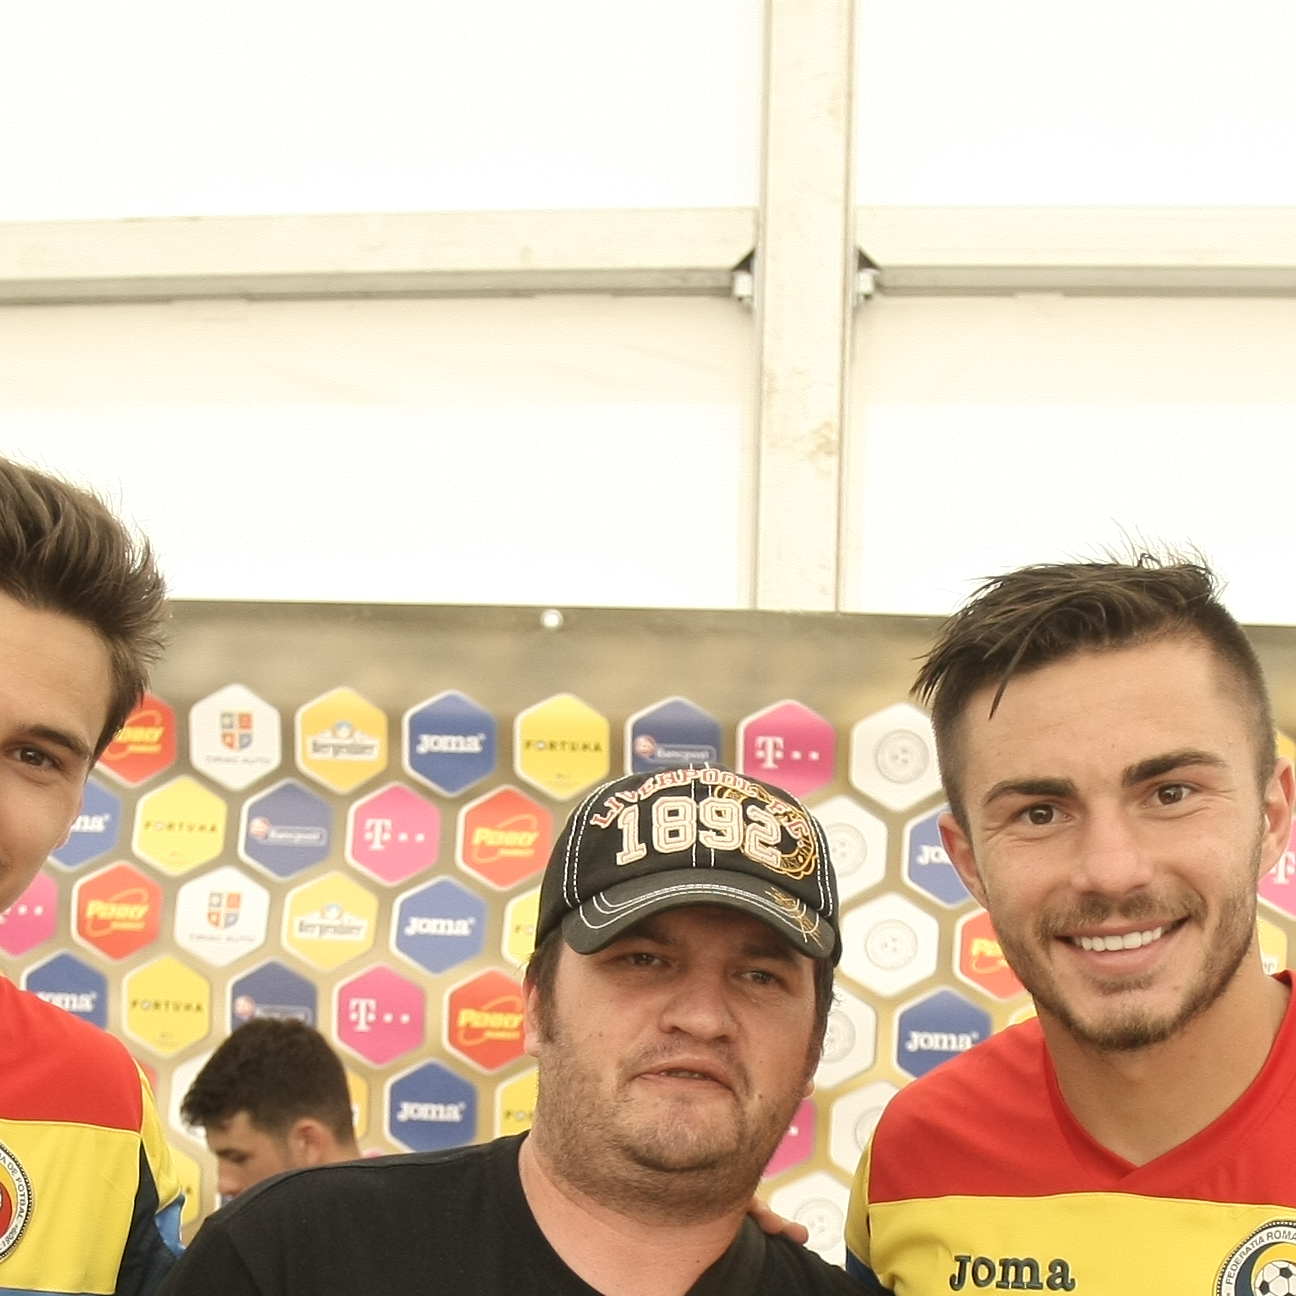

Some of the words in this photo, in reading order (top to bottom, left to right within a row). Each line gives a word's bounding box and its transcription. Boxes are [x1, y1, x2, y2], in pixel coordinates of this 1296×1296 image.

[590, 768, 760, 828] LIVERPOOL
[616, 796, 782, 867] 1892
[950, 1255, 1076, 1291] Joma
